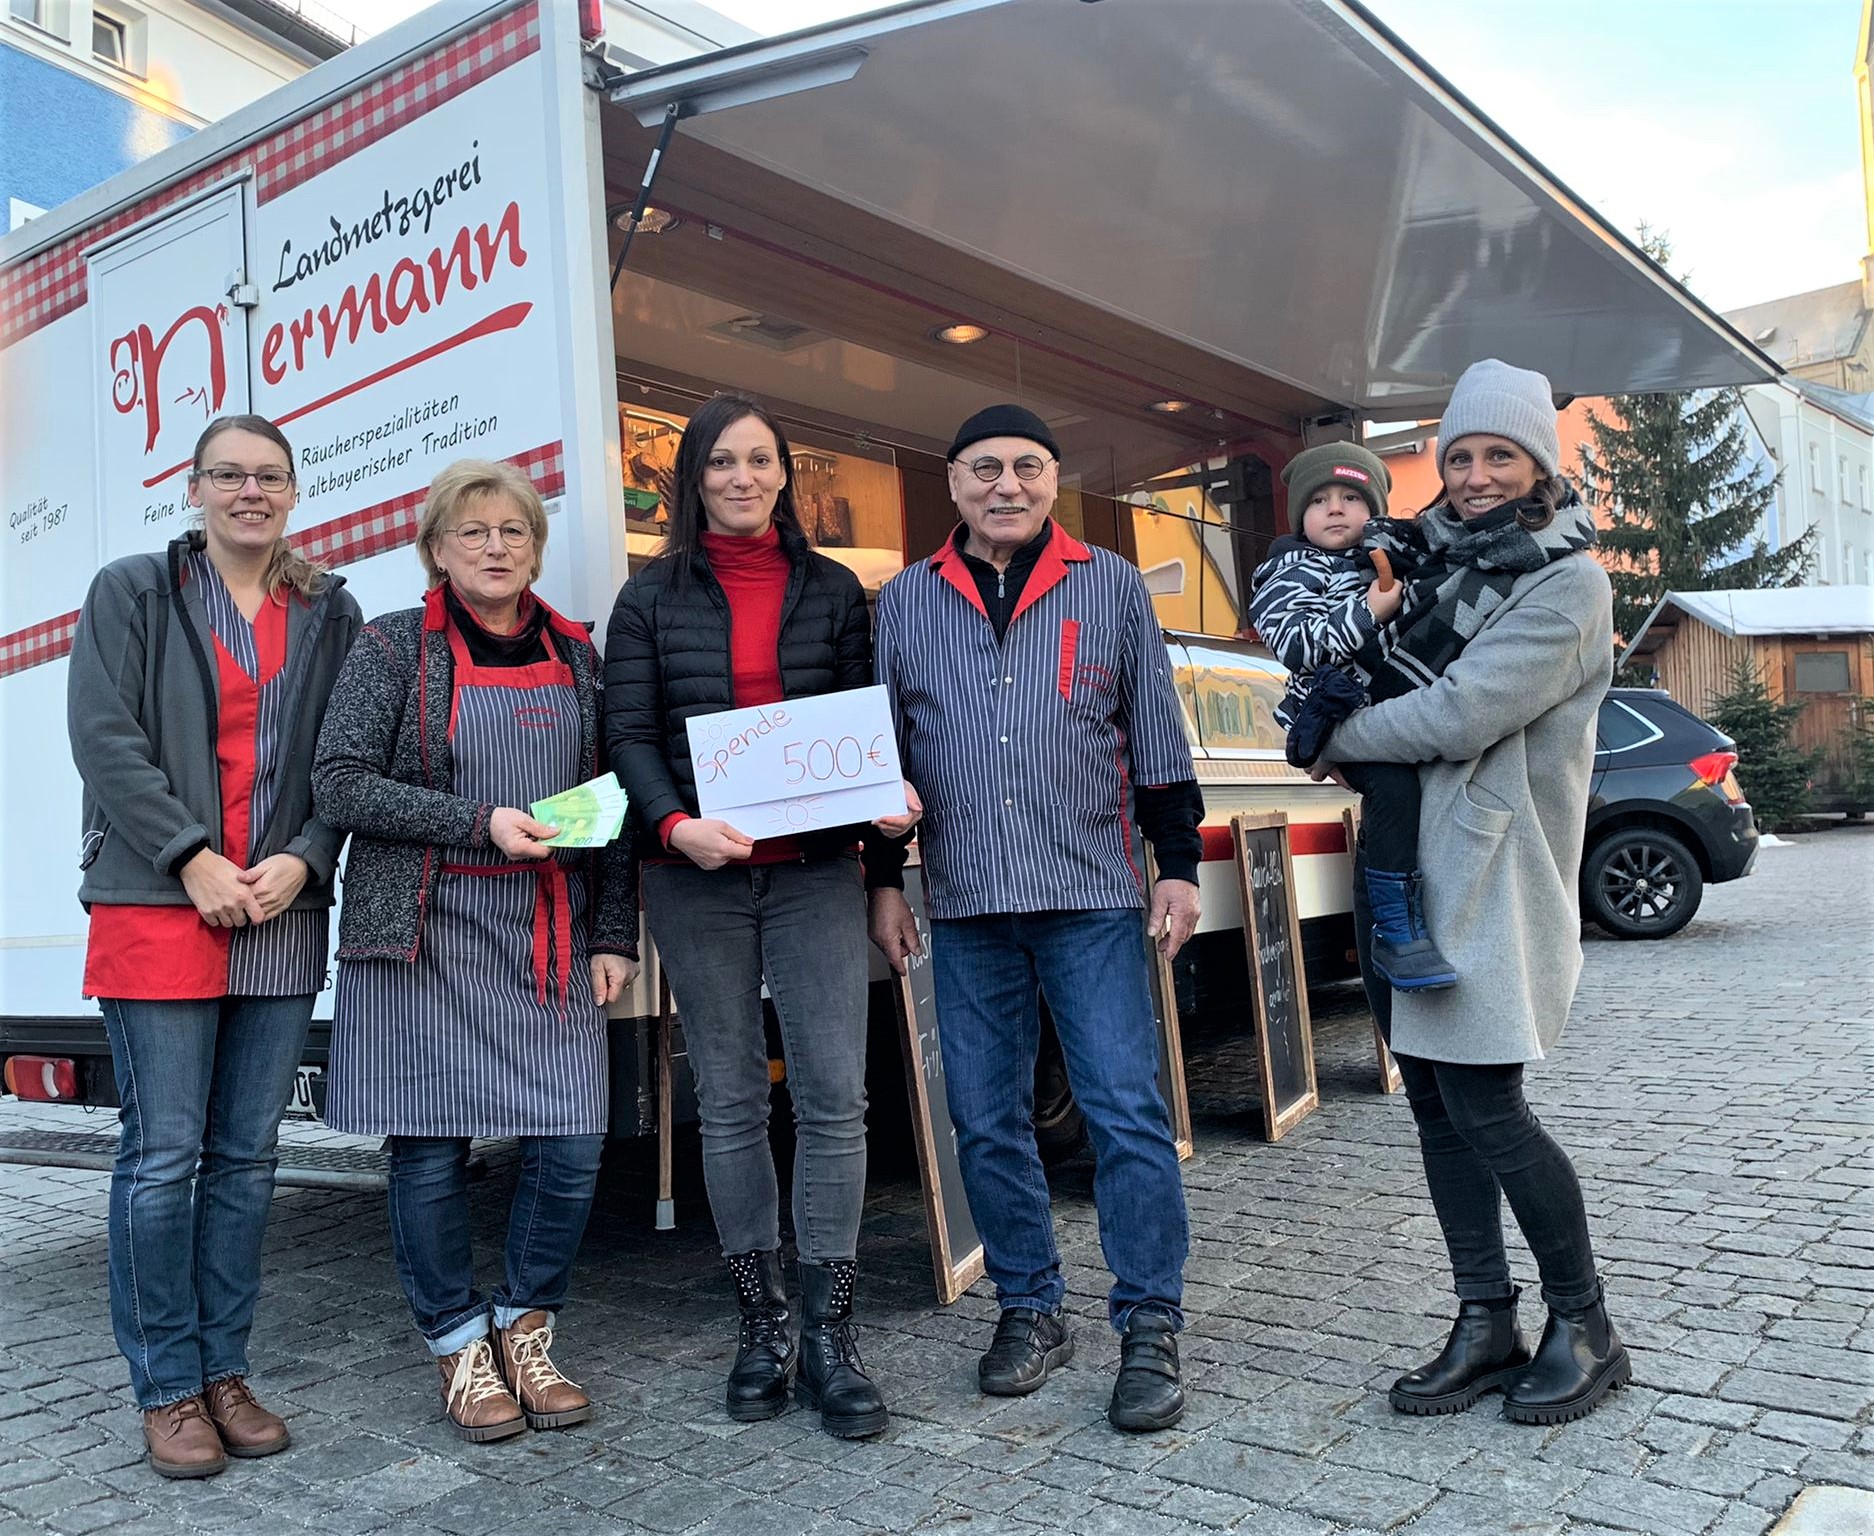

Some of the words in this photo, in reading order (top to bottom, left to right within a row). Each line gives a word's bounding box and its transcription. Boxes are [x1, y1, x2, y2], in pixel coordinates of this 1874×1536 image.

[272, 140, 482, 292] Landmetzgerei
[143, 502, 175, 526] Feine
[300, 394, 459, 469] Räucherspezialitäten
[308, 448, 413, 498] altbayerischer
[421, 415, 498, 455] Tradition
[9, 495, 49, 530] Qualität
[20, 522, 39, 544] seit
[43, 503, 68, 532] 1987
[696, 708, 793, 784] Spende
